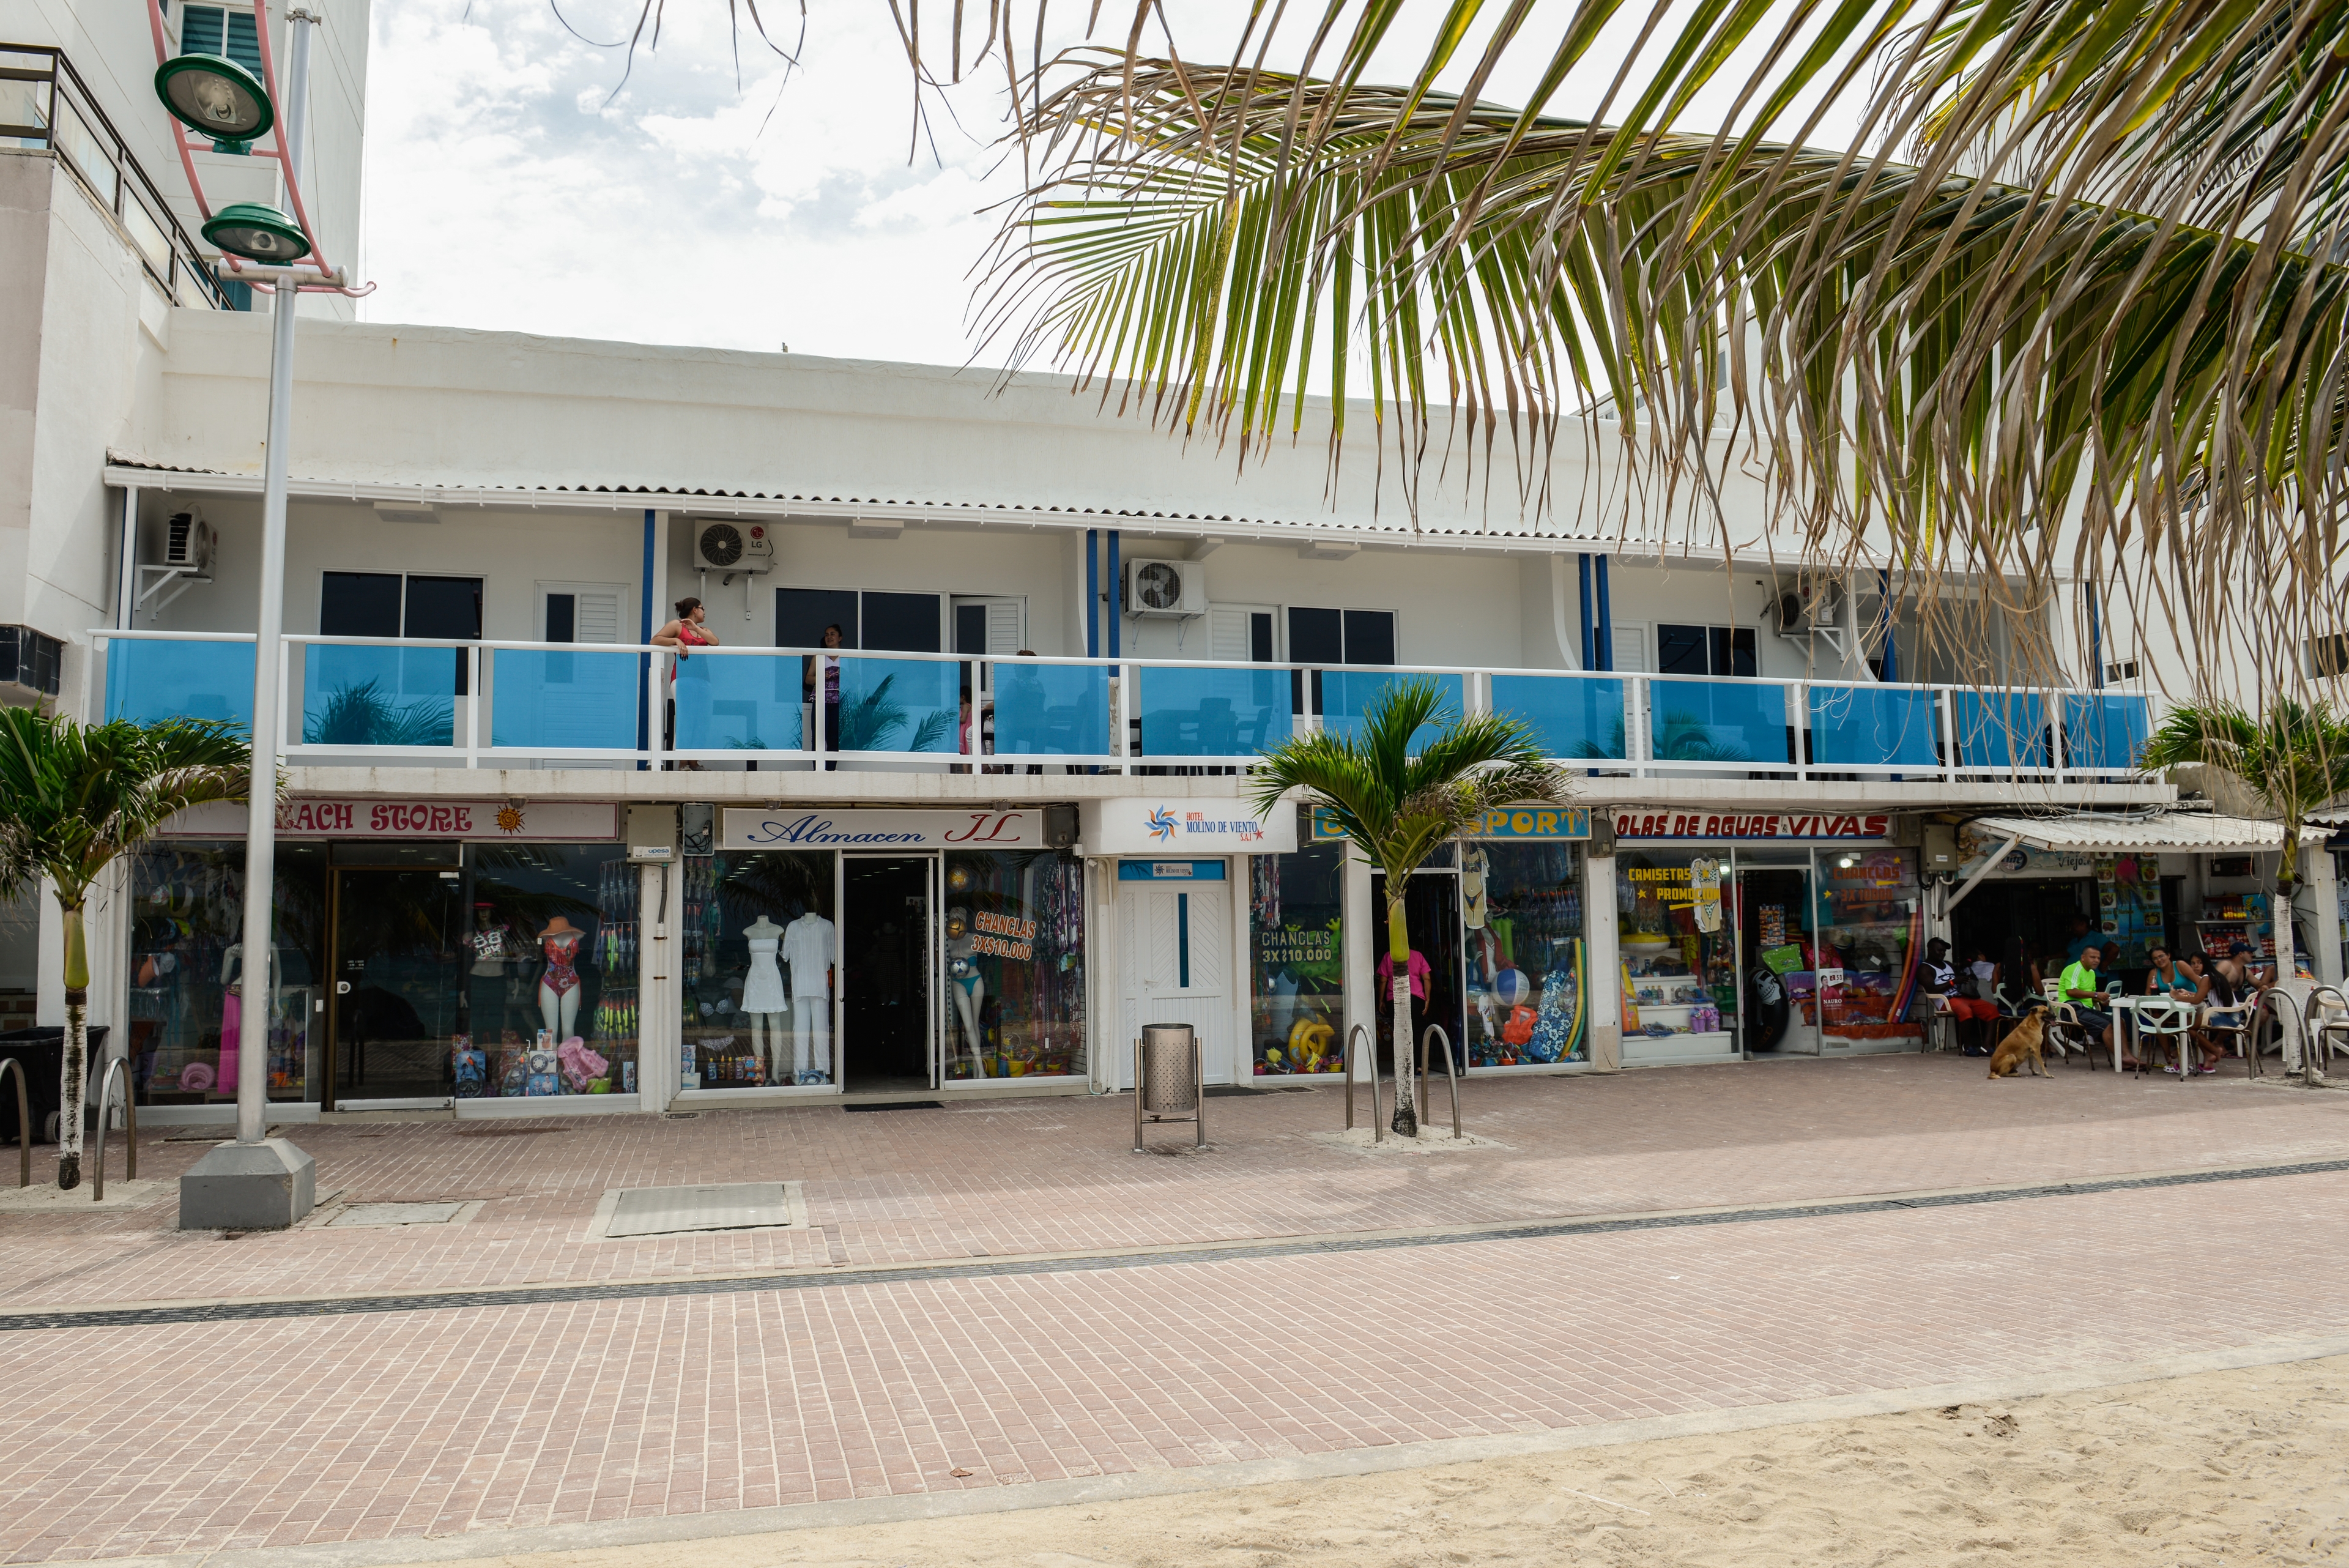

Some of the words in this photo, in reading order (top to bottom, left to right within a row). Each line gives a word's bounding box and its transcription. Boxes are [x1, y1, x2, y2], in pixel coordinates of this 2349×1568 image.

[370, 804, 472, 833] STORE
[1617, 814, 1668, 836] OLAS
[1673, 815, 1699, 836] DE
[1705, 815, 1779, 837] AGUAS
[1787, 815, 1889, 836] VIVAS
[747, 814, 926, 843] Almacen
[1186, 821, 1215, 833] MOLINO
[1218, 821, 1227, 833] DE
[1230, 821, 1257, 833] VIENTO
[1240, 833, 1252, 841] S.A.I
[1628, 868, 1692, 881] CAMISETAS
[1833, 866, 1900, 880] CHANCLAS
[1657, 888, 1720, 900] PROMOCION
[1840, 888, 1855, 901] 3X
[1858, 888, 1893, 901] 10000
[975, 911, 1036, 940] CHANCLAS
[1262, 931, 1330, 946] CHANCLAS
[971, 935, 1032, 960] 3X$10.000
